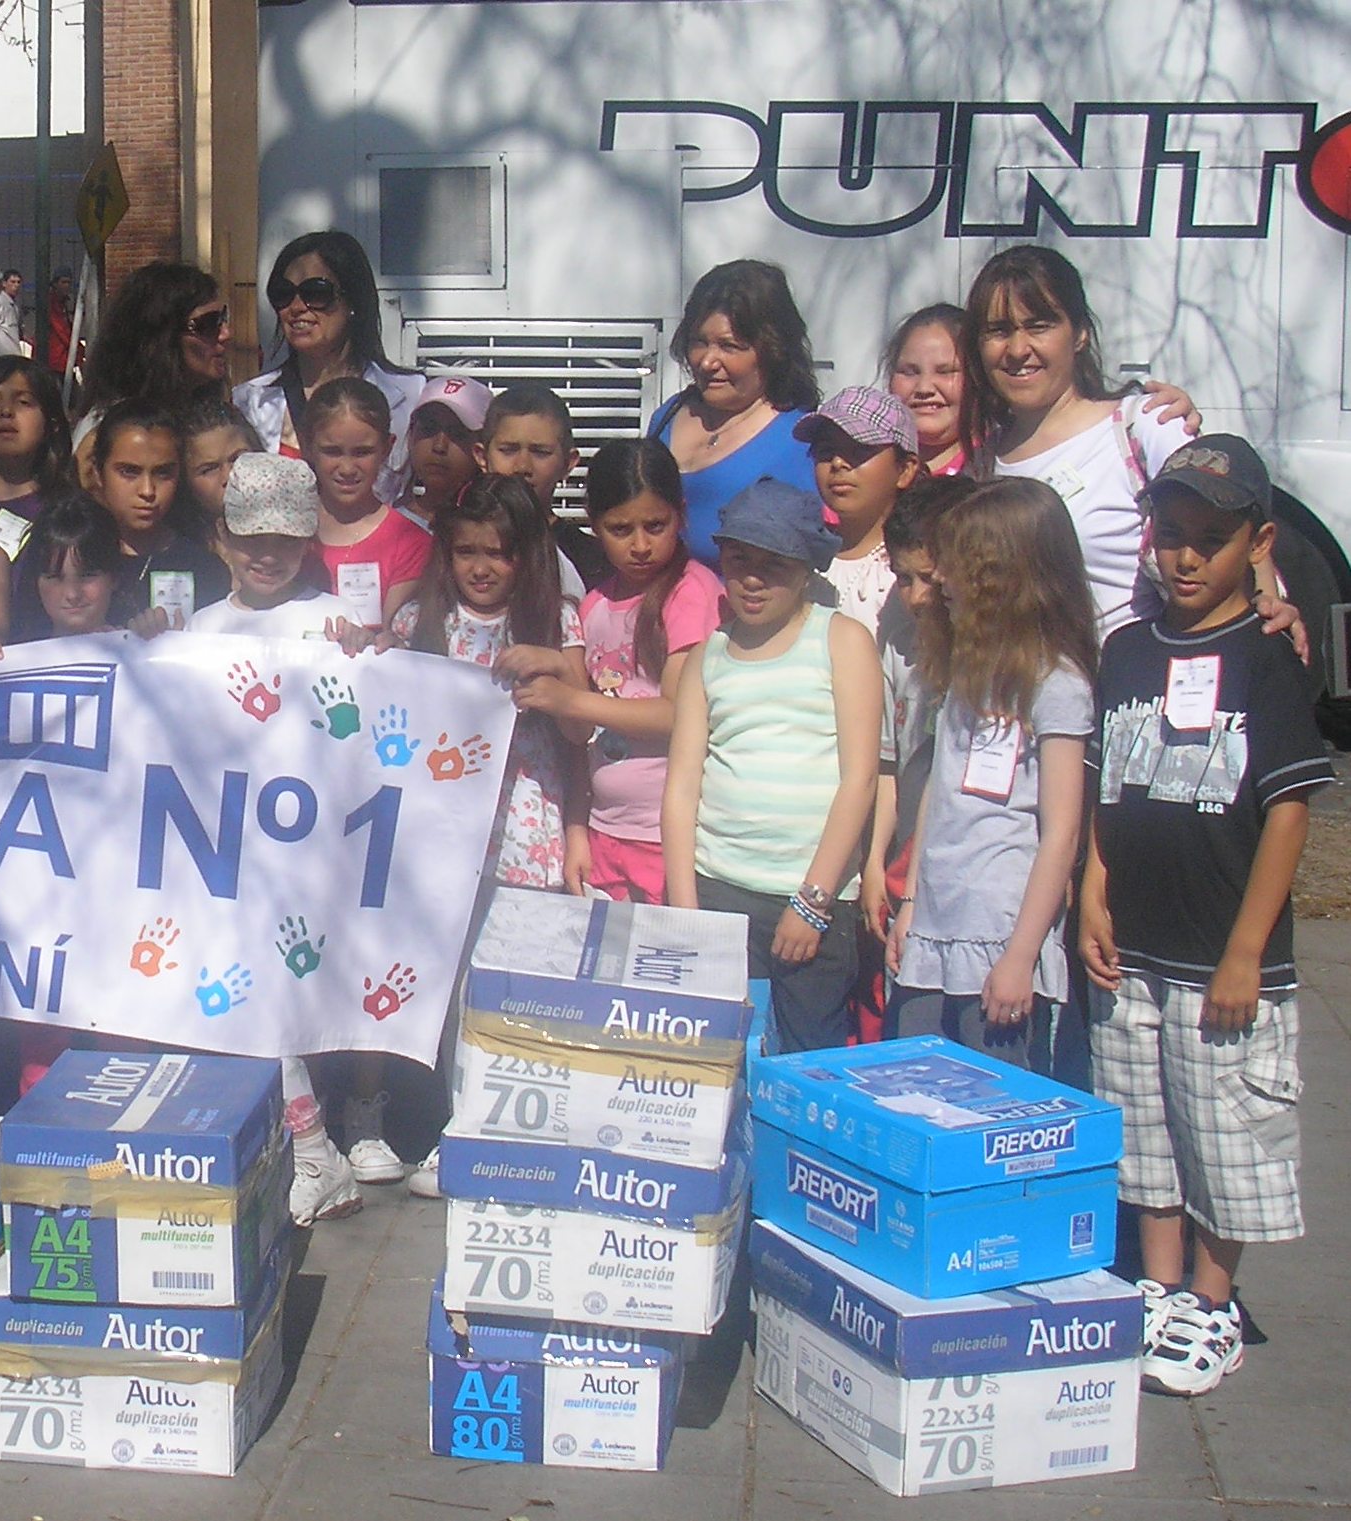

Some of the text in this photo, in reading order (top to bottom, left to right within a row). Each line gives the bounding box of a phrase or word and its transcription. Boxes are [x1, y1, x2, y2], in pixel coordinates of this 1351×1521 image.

[343, 784, 403, 908] 1
[500, 998, 709, 1047] duplicación Autor
[65, 1057, 151, 1108] Autor
[617, 1064, 700, 1099] Autor
[483, 1081, 550, 1131] 70
[606, 1094, 698, 1119] duplicación
[991, 1122, 1071, 1158] REPORT
[16, 1142, 216, 1185] multifunción Autor
[472, 1161, 557, 1183] duplicación
[573, 1157, 678, 1211] Autor
[792, 1163, 873, 1221] REPORT
[30, 1216, 93, 1254] A4
[157, 1206, 216, 1229] Autor
[465, 1221, 553, 1250] 22x34
[140, 1229, 215, 1244] multifunción
[599, 1229, 679, 1263] Autor
[30, 1257, 80, 1290] 75
[463, 1253, 533, 1302] 70
[587, 1261, 676, 1284] duplicación
[946, 1250, 973, 1272] A4
[5, 1313, 204, 1353] duplicación Autor
[829, 1284, 885, 1350] Autor
[931, 1316, 1117, 1356] duplicación Autor
[452, 1370, 522, 1412] A4
[580, 1373, 640, 1396] Autor
[1057, 1379, 1116, 1405] Autor
[115, 1409, 199, 1429] duplicación
[563, 1397, 637, 1412] multifunción
[807, 1380, 872, 1439] duplicación
[922, 1402, 995, 1429] 22x34
[1045, 1401, 1112, 1423] duplicación
[0, 1404, 66, 1451] 70
[451, 1414, 510, 1451] 80
[166, 1447, 199, 1456] Ledesma
[919, 1434, 978, 1479] 70
